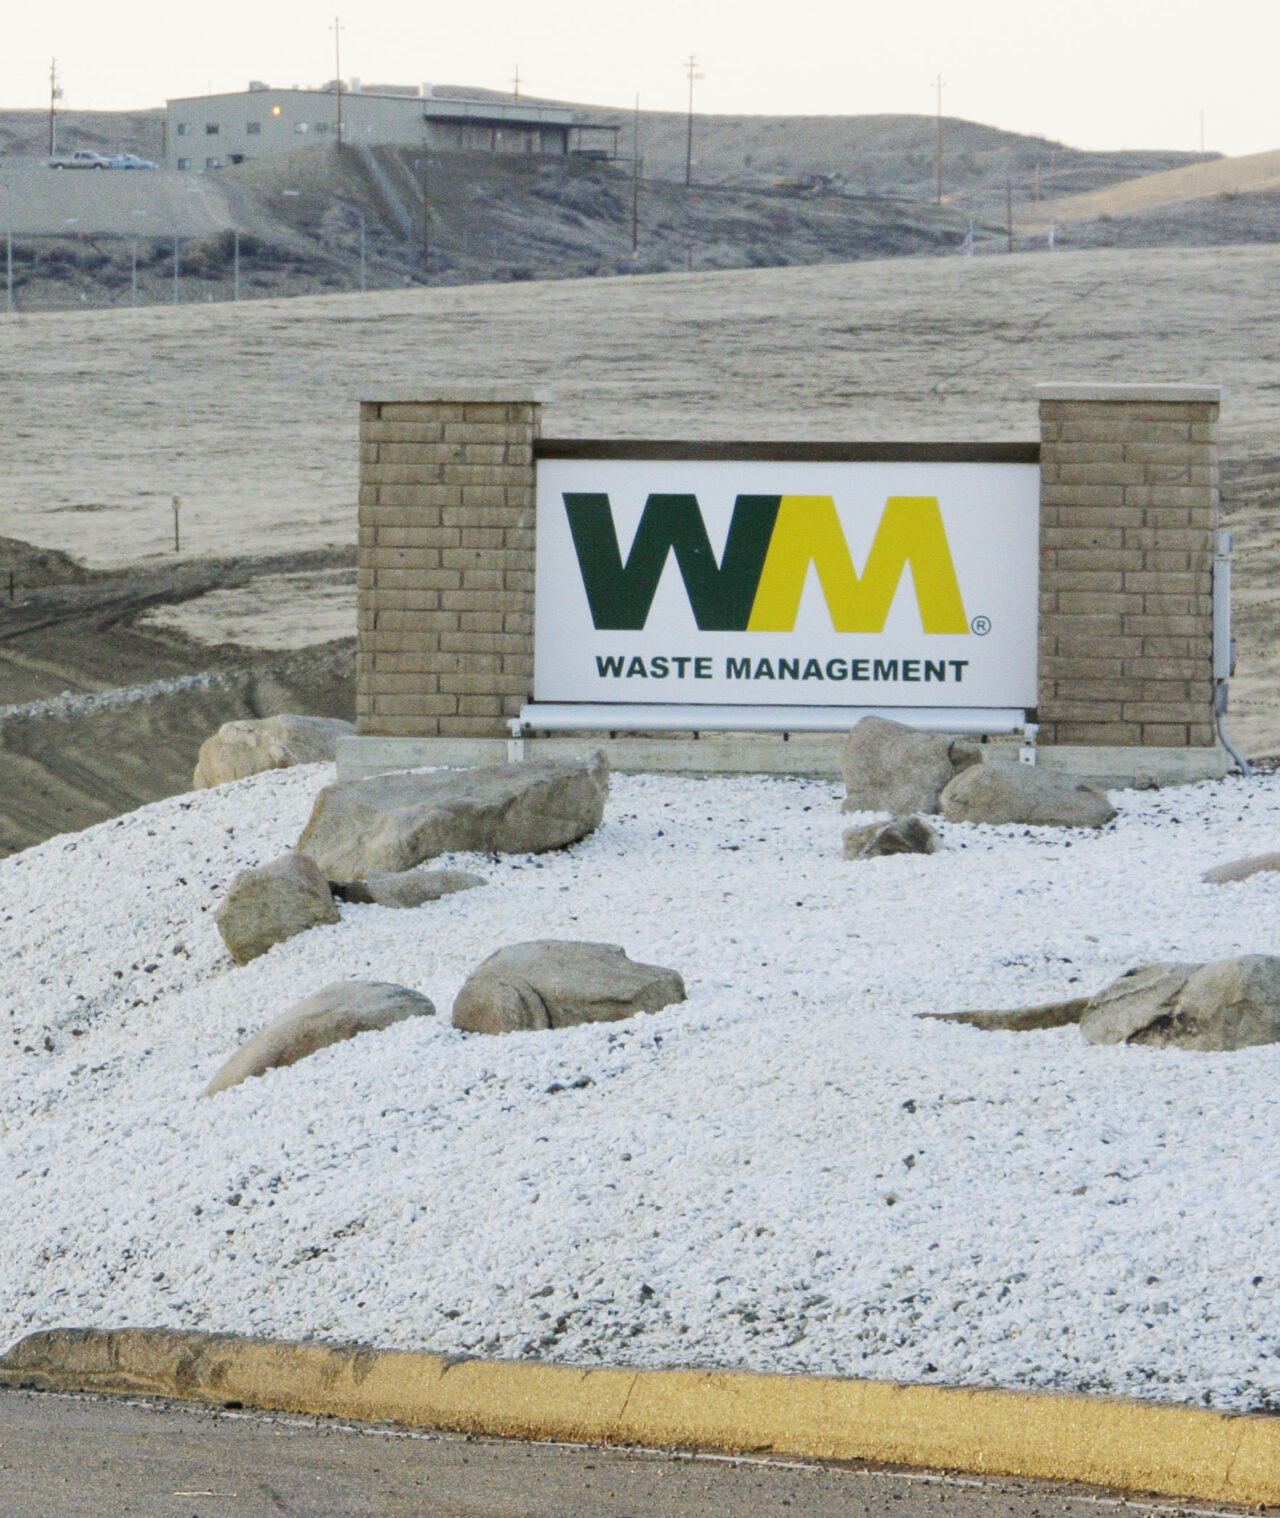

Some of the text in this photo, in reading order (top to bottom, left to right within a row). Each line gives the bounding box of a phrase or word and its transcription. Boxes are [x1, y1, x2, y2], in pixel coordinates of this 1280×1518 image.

[562, 492, 970, 635] WM
[595, 655, 970, 683] WASTE MANAGEMENT
